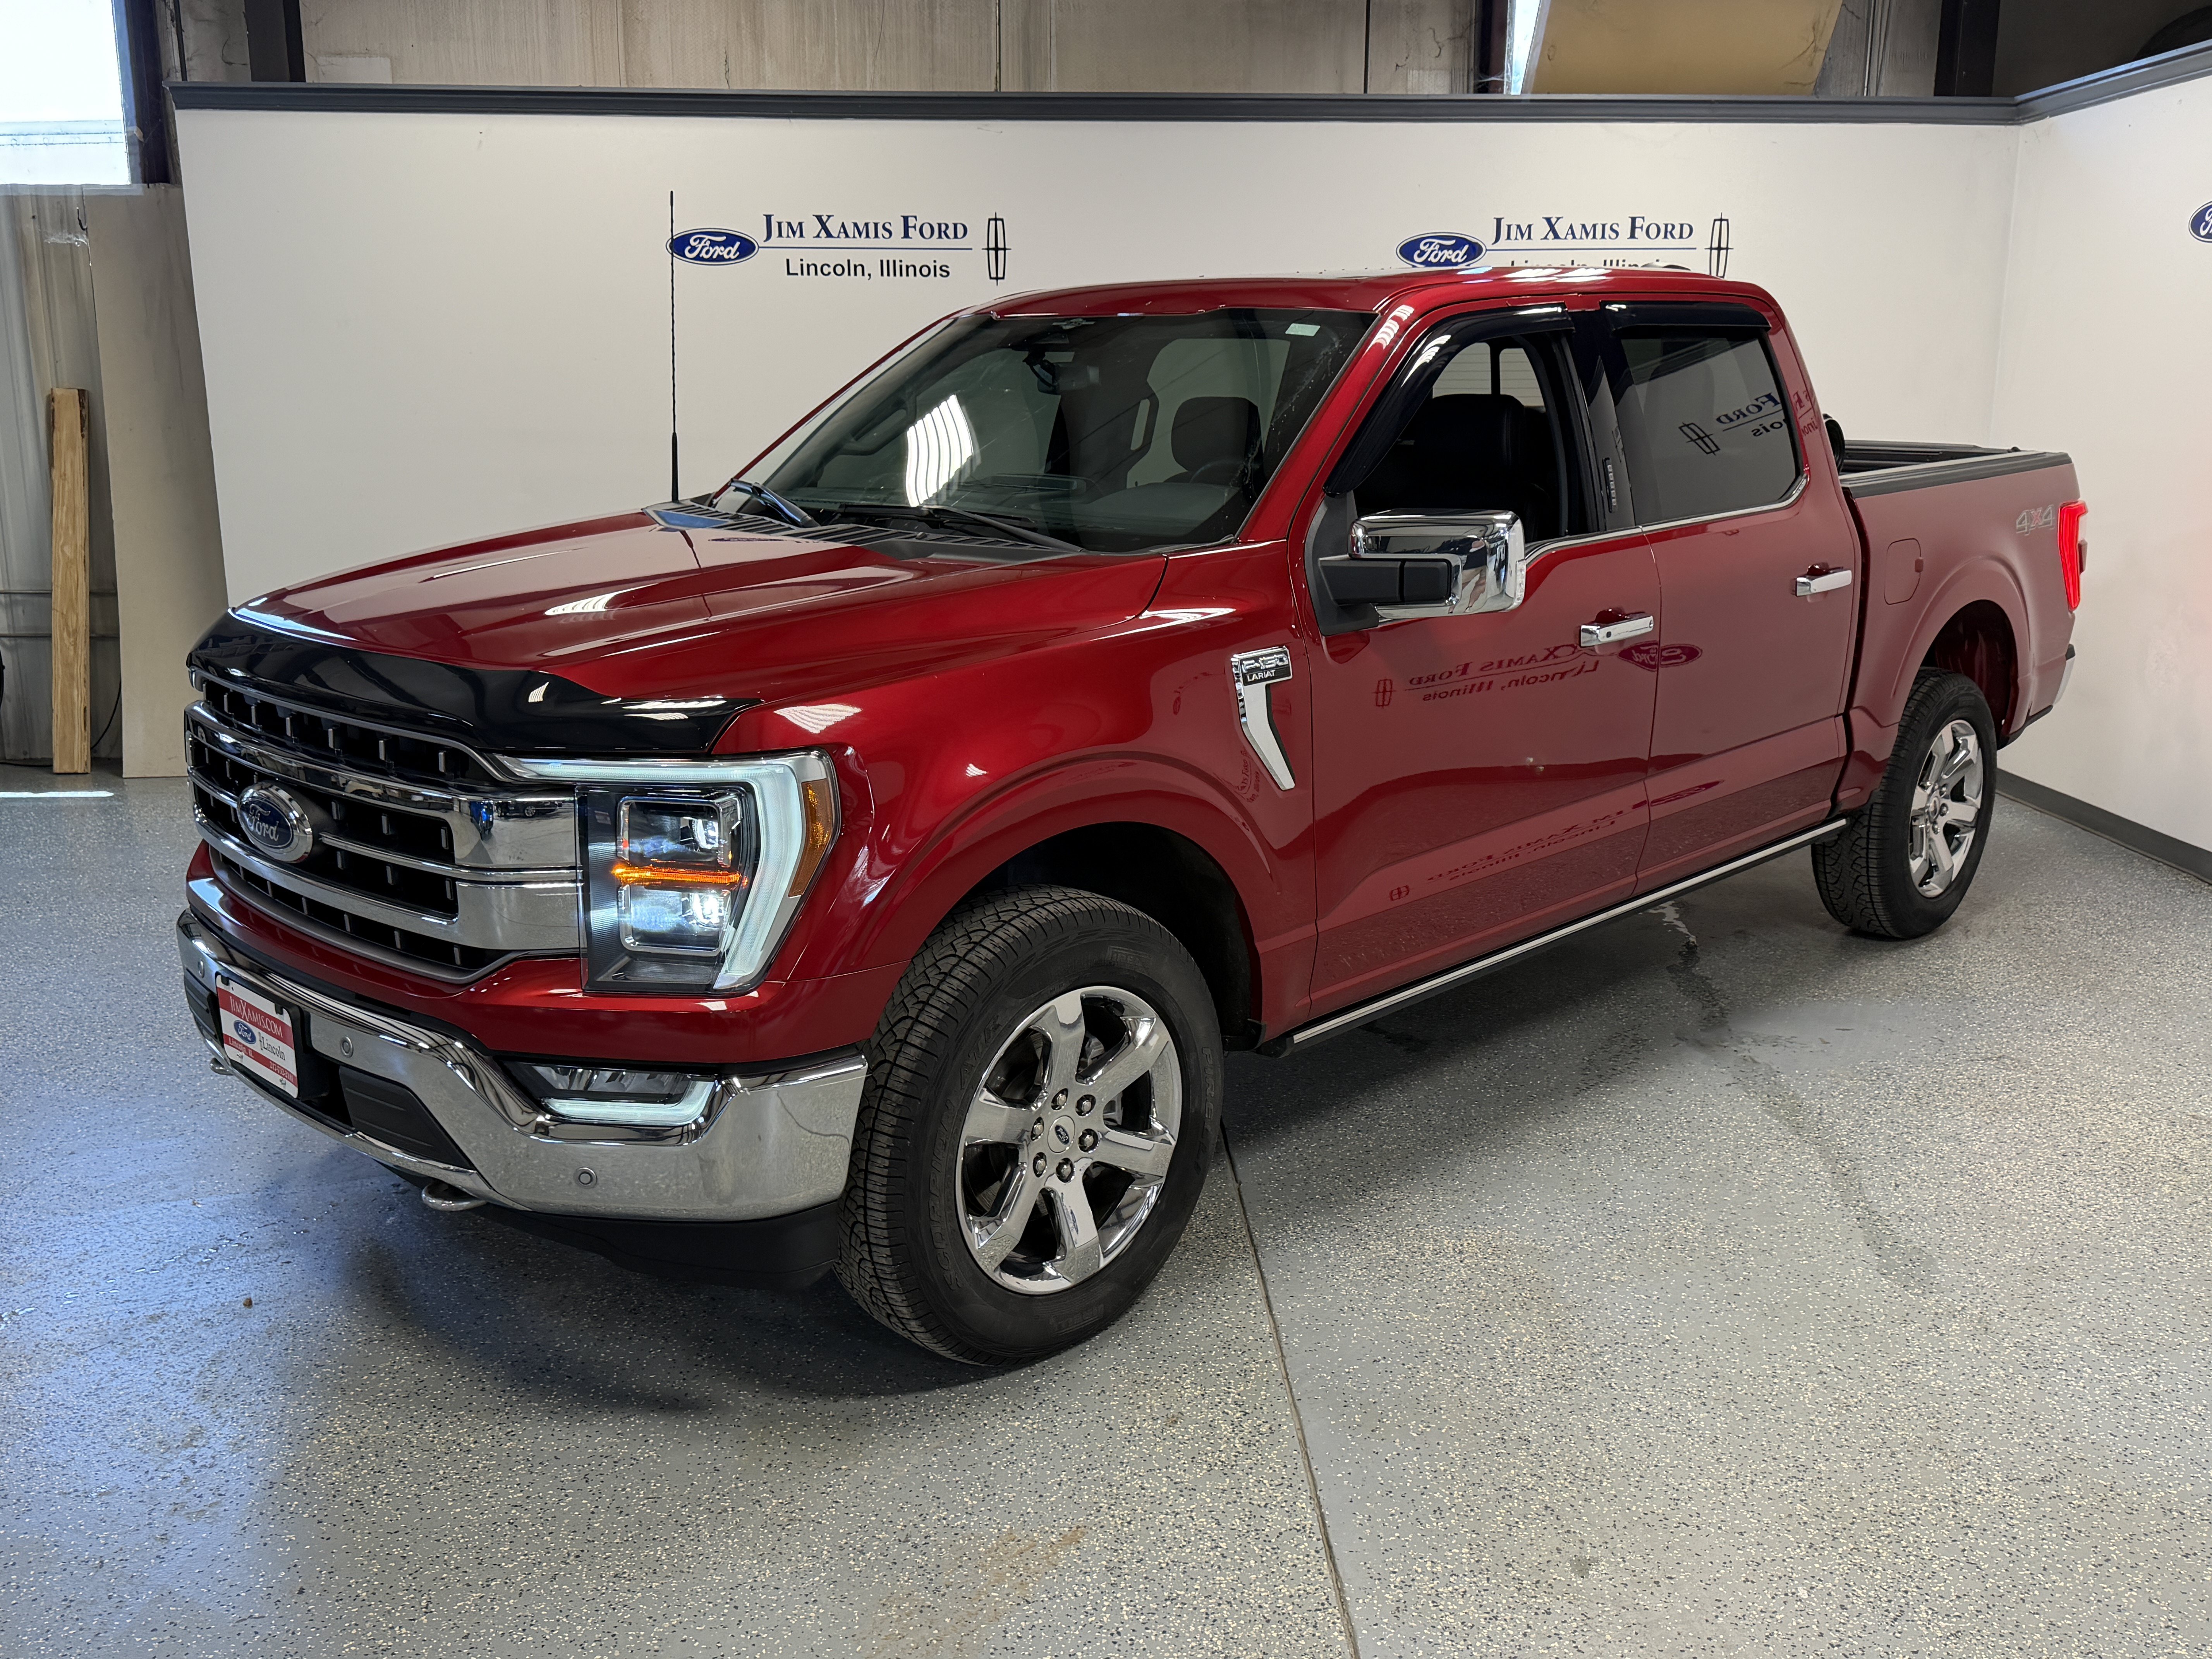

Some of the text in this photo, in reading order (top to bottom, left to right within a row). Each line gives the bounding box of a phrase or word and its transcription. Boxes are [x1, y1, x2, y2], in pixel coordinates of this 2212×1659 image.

[763, 214, 968, 242] JIM XAMIS FORD
[1492, 216, 1693, 245] JIM XAMIS FORD
[684, 234, 740, 260] Ford
[1413, 237, 1468, 263] Ford
[786, 258, 950, 280] Lincoln, Illinois
[1247, 670, 1276, 682] LARIAT
[249, 803, 280, 842] Ford
[238, 1023, 252, 1041] Ford
[261, 1036, 286, 1061] Lincoln
[1056, 1127, 1069, 1142] Ford
